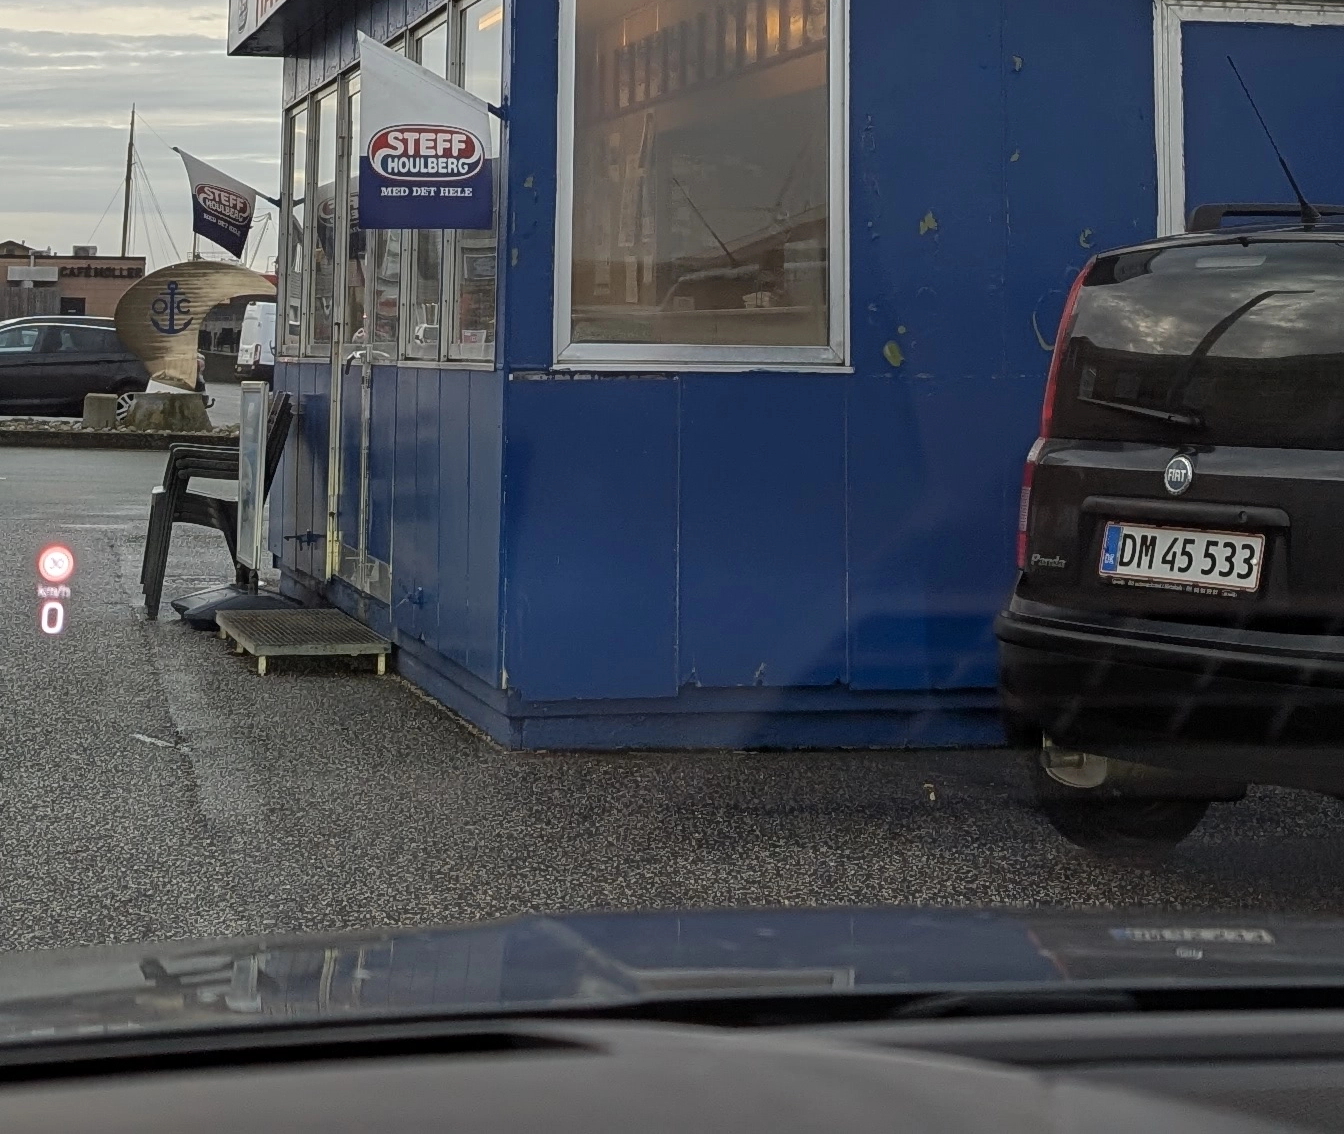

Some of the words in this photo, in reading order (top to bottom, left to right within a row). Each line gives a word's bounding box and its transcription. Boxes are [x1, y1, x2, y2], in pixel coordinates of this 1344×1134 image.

[387, 131, 467, 157] STEFF
[387, 157, 469, 174] HOULBERG
[204, 186, 244, 211] STEFF
[380, 186, 409, 197] MED
[412, 187, 437, 197] DET
[440, 187, 473, 197] HELE
[1167, 467, 1187, 483] FIAT
[1030, 553, 1067, 568] Panda
[1118, 533, 1158, 570] DM
[1161, 537, 1194, 574] 45
[1201, 540, 1256, 580] 533
[41, 601, 64, 634] 0
